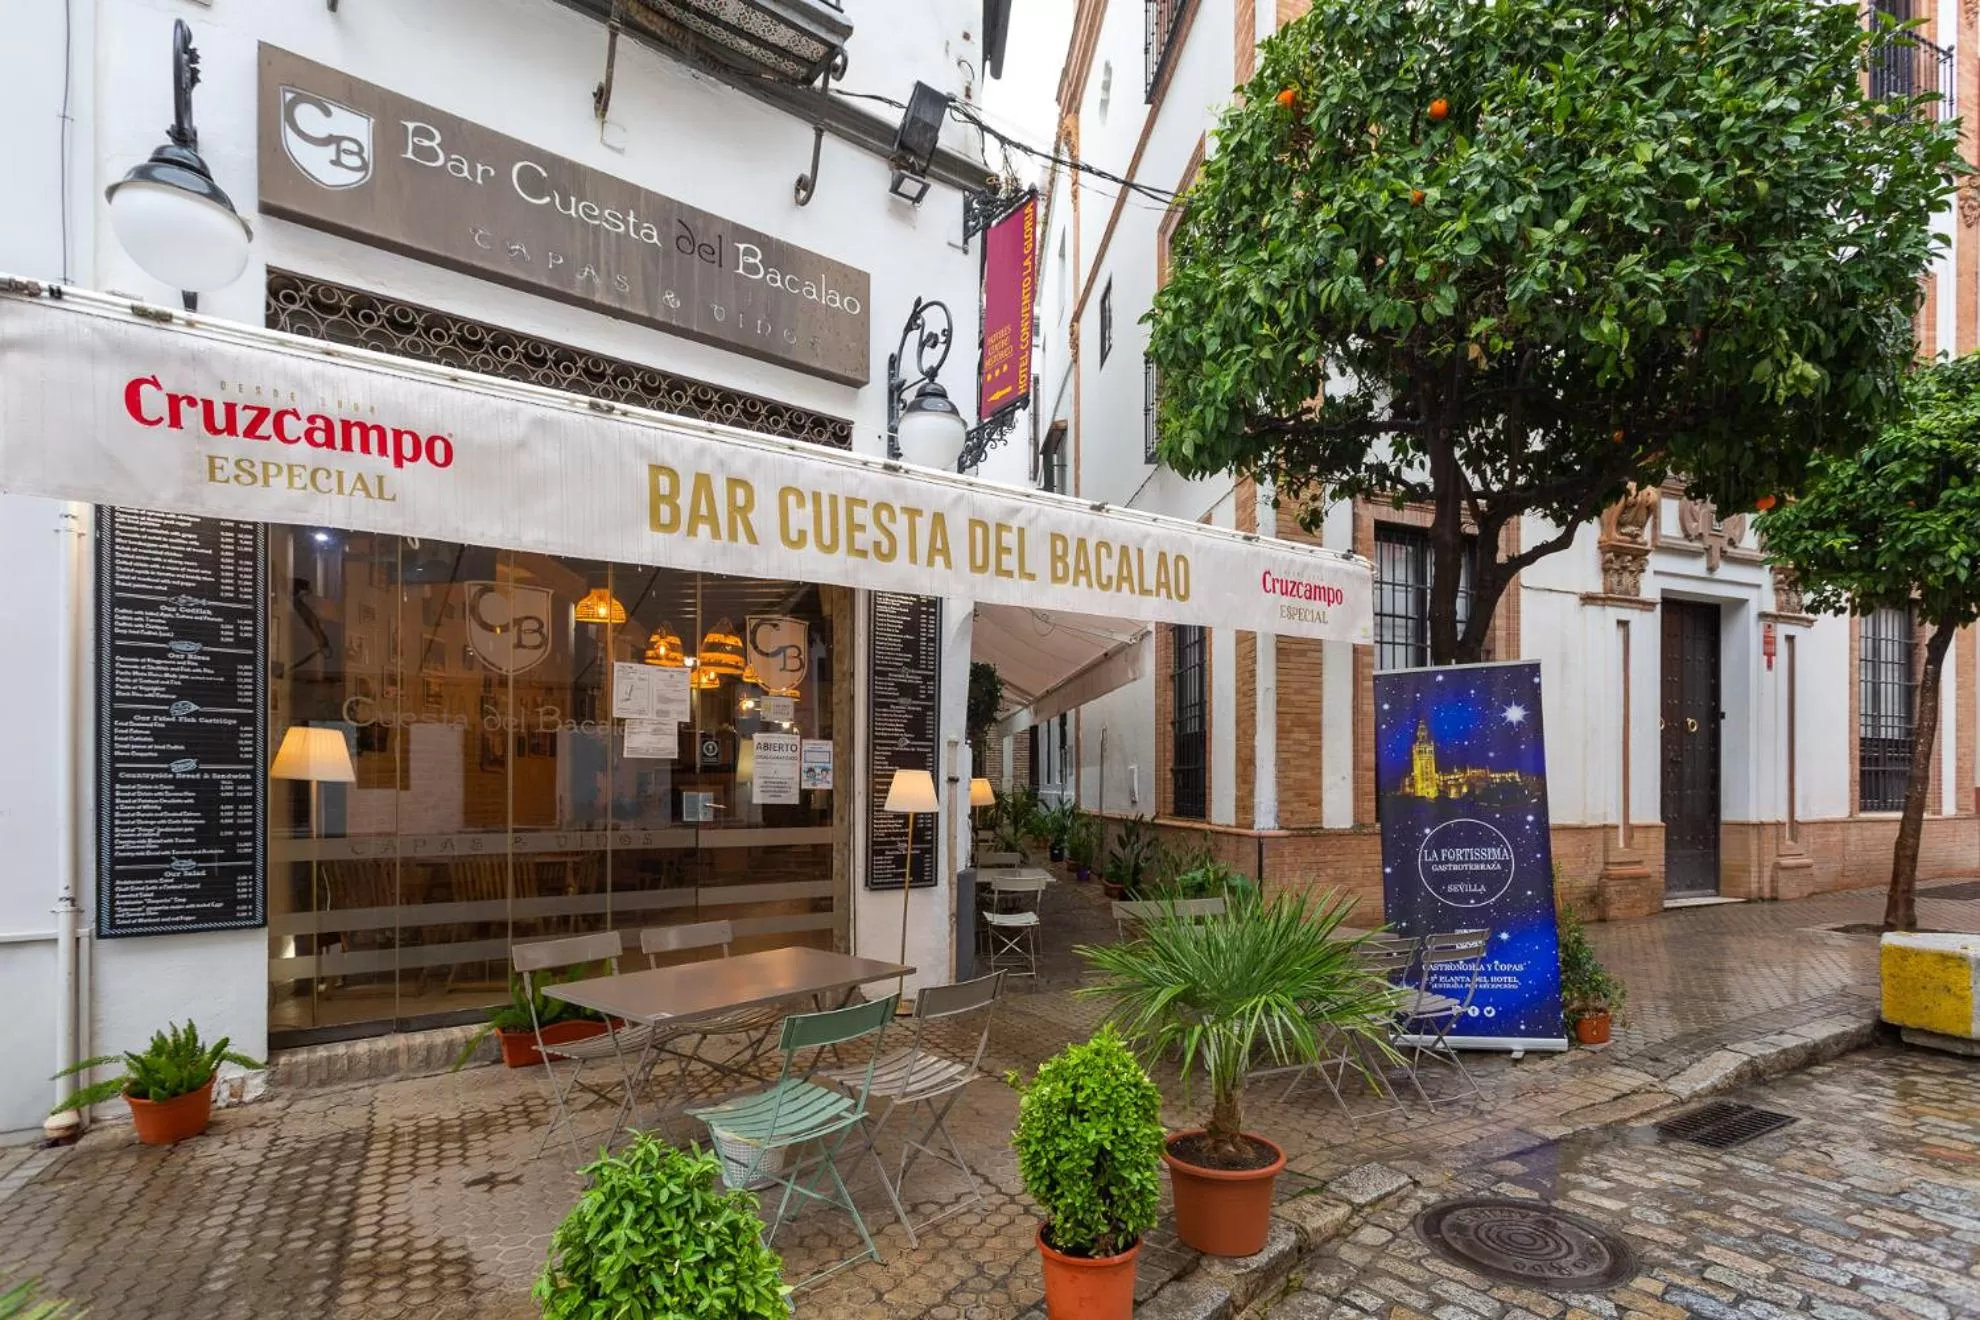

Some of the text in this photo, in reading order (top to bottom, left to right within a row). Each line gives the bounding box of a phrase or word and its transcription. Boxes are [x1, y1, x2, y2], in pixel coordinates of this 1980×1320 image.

[400, 119, 862, 316] Bar Cuesta del Bacalao
[1017, 200, 1034, 395] HOTEL CONVENTO LA GLORIA
[124, 374, 454, 469] Cruzcampo
[205, 454, 398, 502] ESPECIAL
[647, 463, 1193, 603] BAR CUESTA DEL BACALAO
[1261, 568, 1345, 608] Cruzcampo
[1279, 604, 1329, 624] ESPECIAL
[342, 696, 625, 736] Cuesta del Bacal
[755, 741, 798, 753] ABIERTO
[1423, 849, 1439, 862] LA
[1447, 882, 1487, 893] SEVILLA
